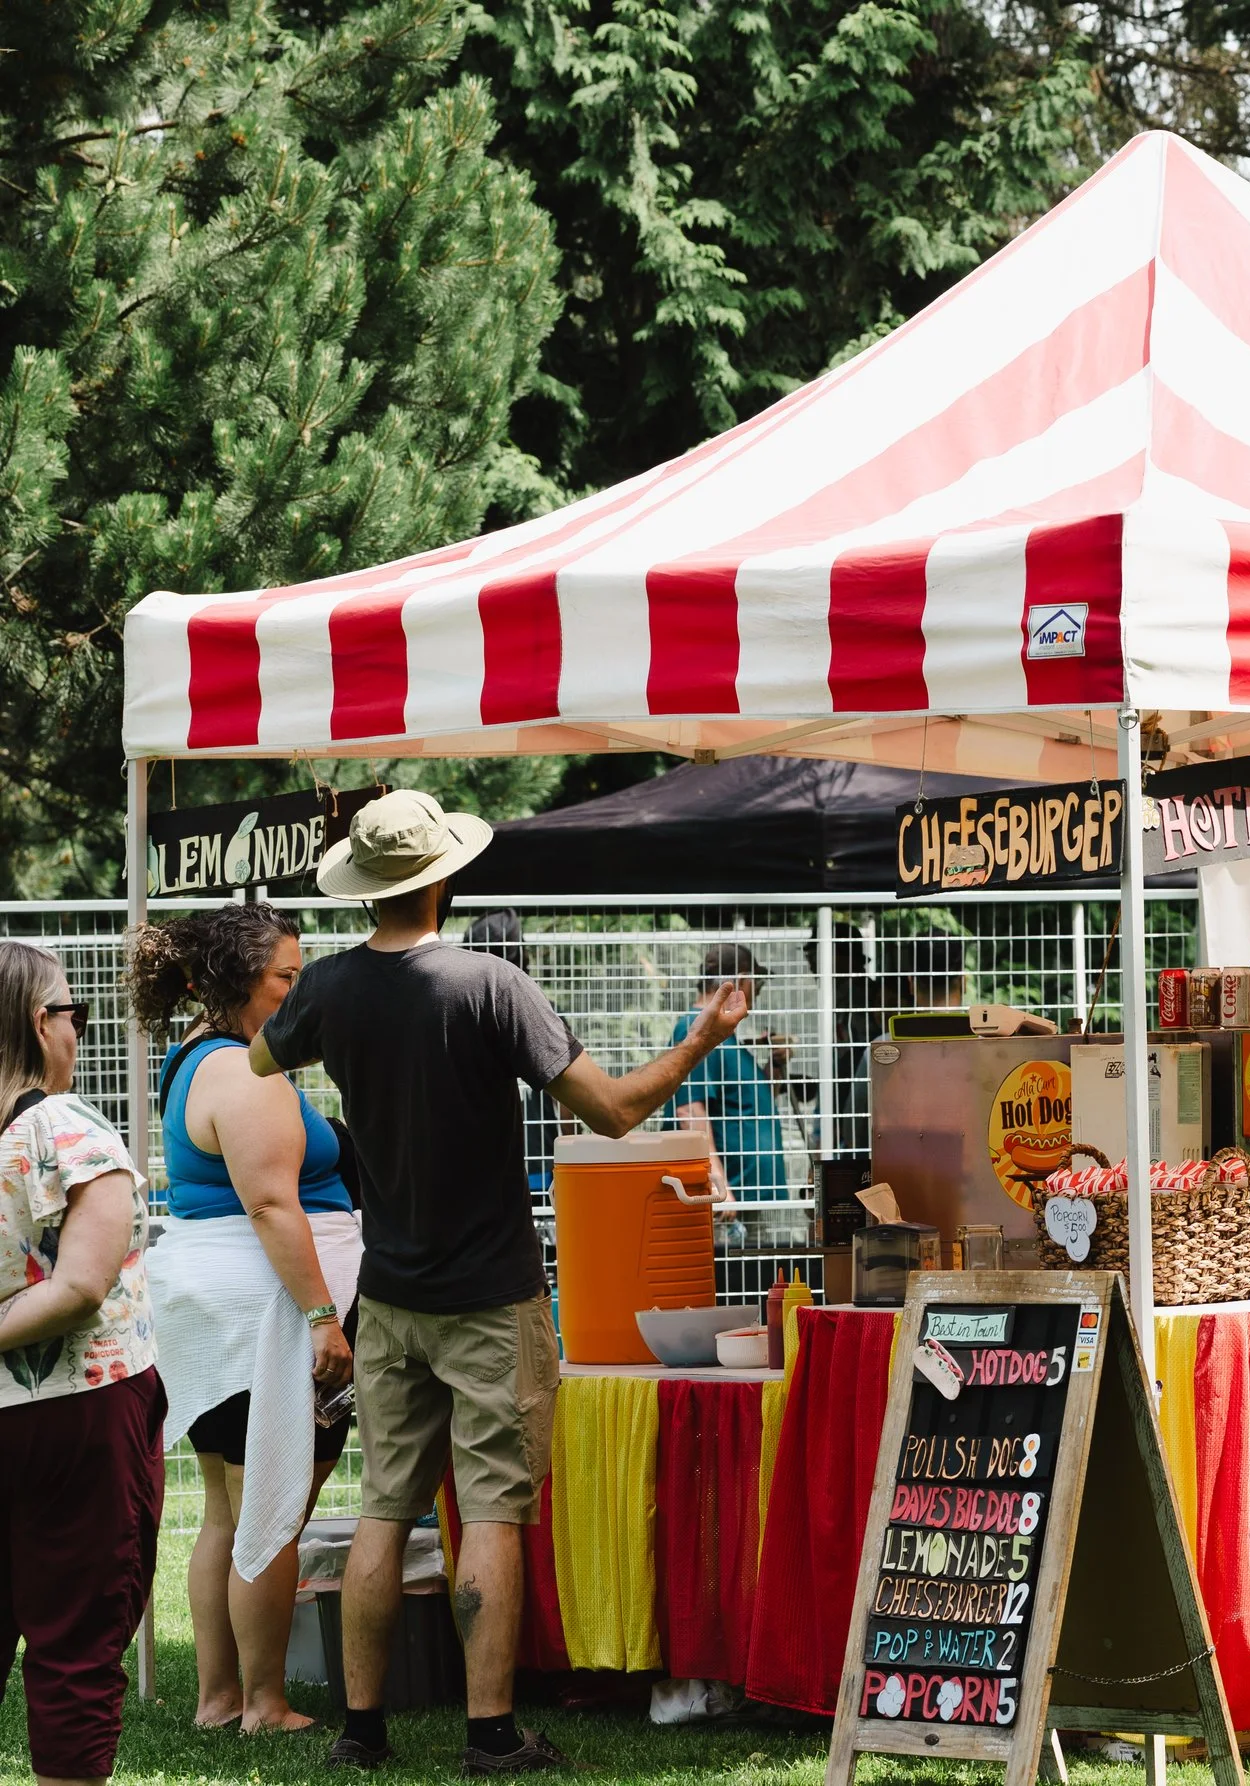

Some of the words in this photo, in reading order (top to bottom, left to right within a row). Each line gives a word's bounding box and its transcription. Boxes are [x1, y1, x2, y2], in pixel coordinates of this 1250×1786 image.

[898, 789, 1122, 888] CHEESEBURGER
[1223, 975, 1236, 1019] Coke
[1000, 1098, 1034, 1129] Hot
[1038, 1092, 1072, 1126] Dog
[1050, 1204, 1089, 1222] POPCORN
[930, 1316, 957, 1337] Best
[956, 1320, 971, 1337] in
[971, 1316, 1006, 1338] Town!
[1080, 1336, 1094, 1344] VISA
[966, 1349, 1048, 1386] HOTDOG
[1046, 1346, 1067, 1386] 5
[901, 1434, 981, 1479] POLISH
[986, 1437, 1022, 1478] DOG
[1018, 1433, 1041, 1478] 8
[889, 1484, 952, 1529] DAVES
[951, 1487, 985, 1532] BIG
[982, 1490, 1021, 1535] DOG
[1018, 1491, 1041, 1536] 8
[882, 1528, 1010, 1578] LEMONADE
[1007, 1535, 1033, 1581] 5
[875, 1576, 1008, 1624] CHEESEBURGER
[999, 1582, 1030, 1625] 12
[873, 1629, 919, 1662] POP
[938, 1629, 997, 1667] WATER
[996, 1630, 1017, 1671] 2
[860, 1670, 999, 1723] POPCORN
[995, 1677, 1020, 1725] 5
